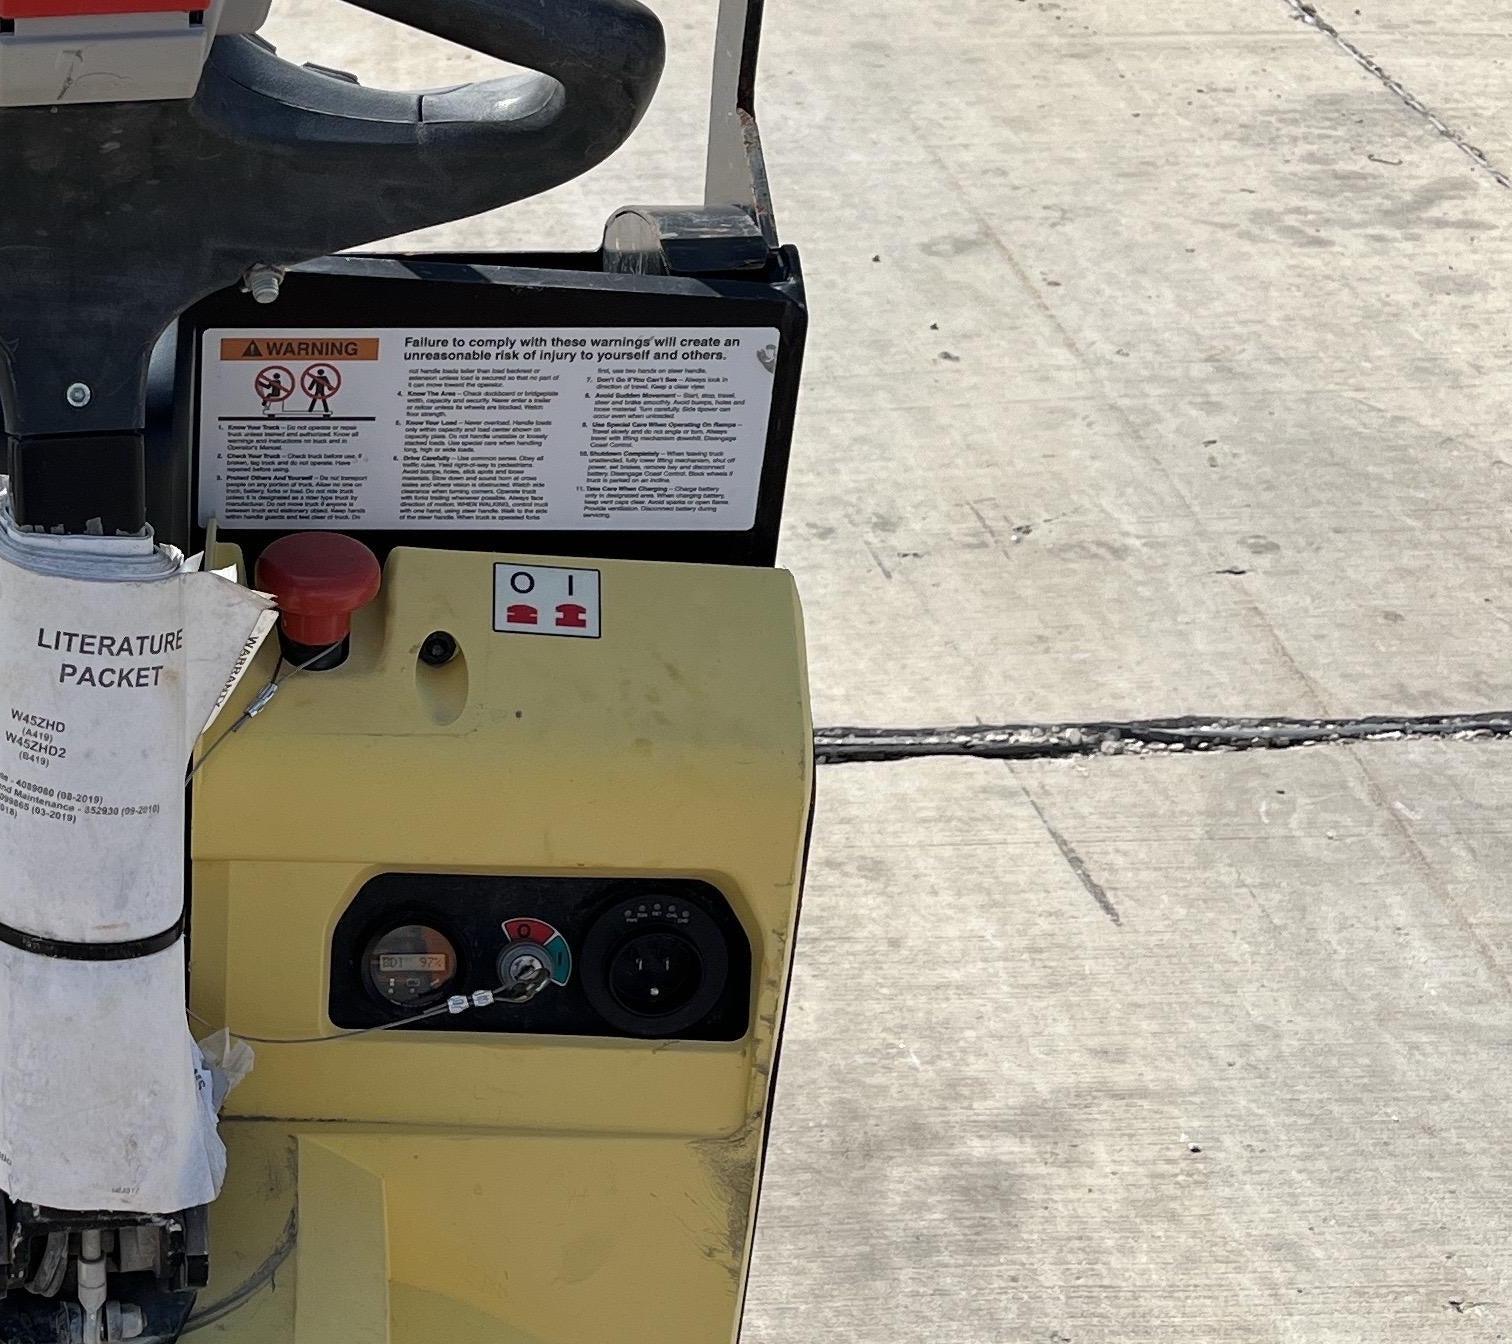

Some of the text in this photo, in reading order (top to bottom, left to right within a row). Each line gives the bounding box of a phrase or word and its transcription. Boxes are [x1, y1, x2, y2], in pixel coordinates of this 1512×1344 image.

[266, 341, 359, 357] WARNING
[404, 336, 740, 349] Failure to comply with these warnings will create an
[403, 349, 728, 363] unreasonable risk of injury to yourself and others.
[38, 627, 184, 657] LITERATURE
[59, 663, 164, 688] PACKET
[11, 708, 66, 733] W45ZHD
[5, 730, 67, 759] W45ZHD2
[14, 788, 75, 812] Maintenance
